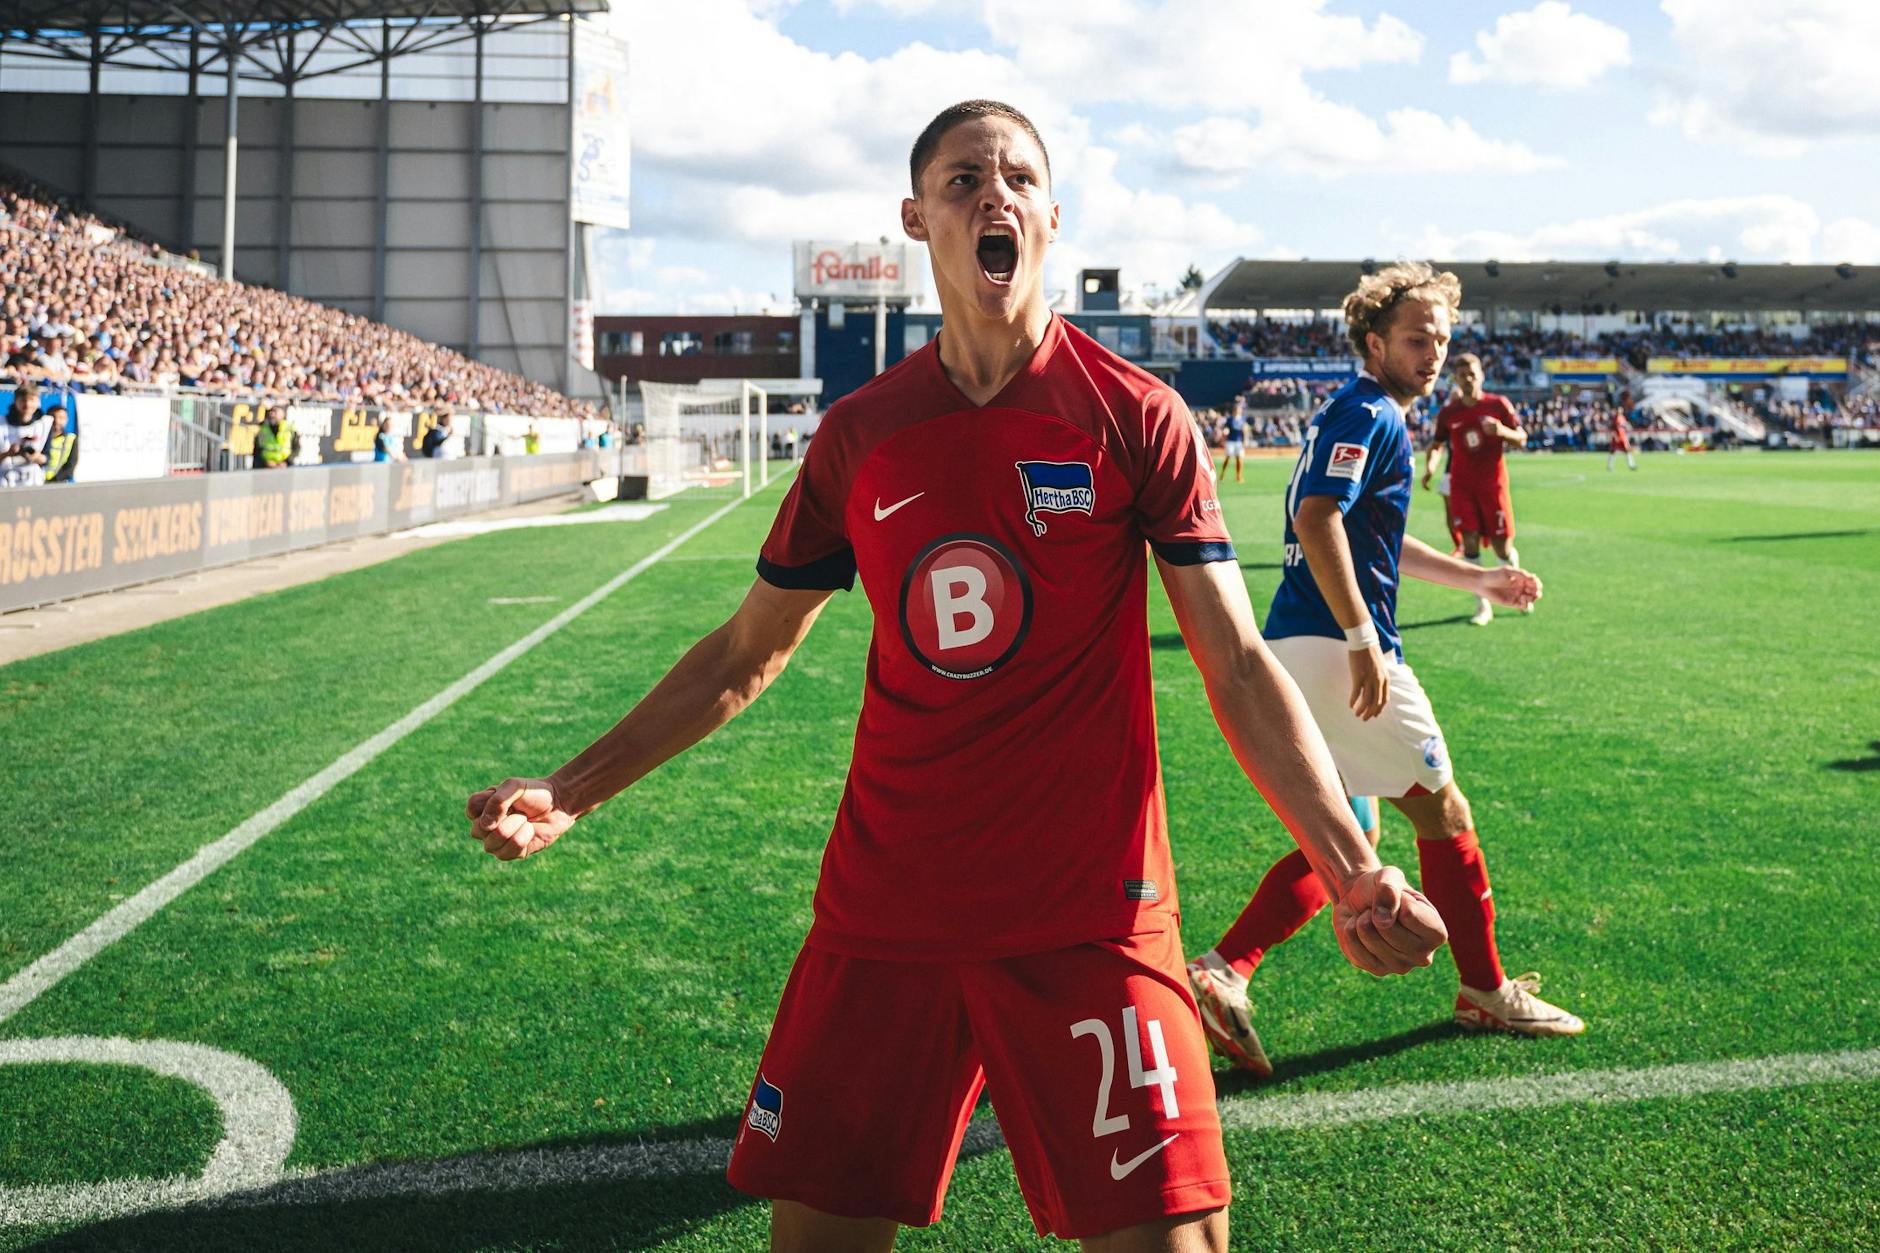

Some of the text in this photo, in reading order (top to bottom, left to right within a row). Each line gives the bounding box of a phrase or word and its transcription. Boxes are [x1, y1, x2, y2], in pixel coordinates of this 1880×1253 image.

[931, 565, 995, 650] B
[931, 664, 993, 679] WWW.CRAZYBUZZER.DE
[1070, 1005, 1180, 1138] 24
